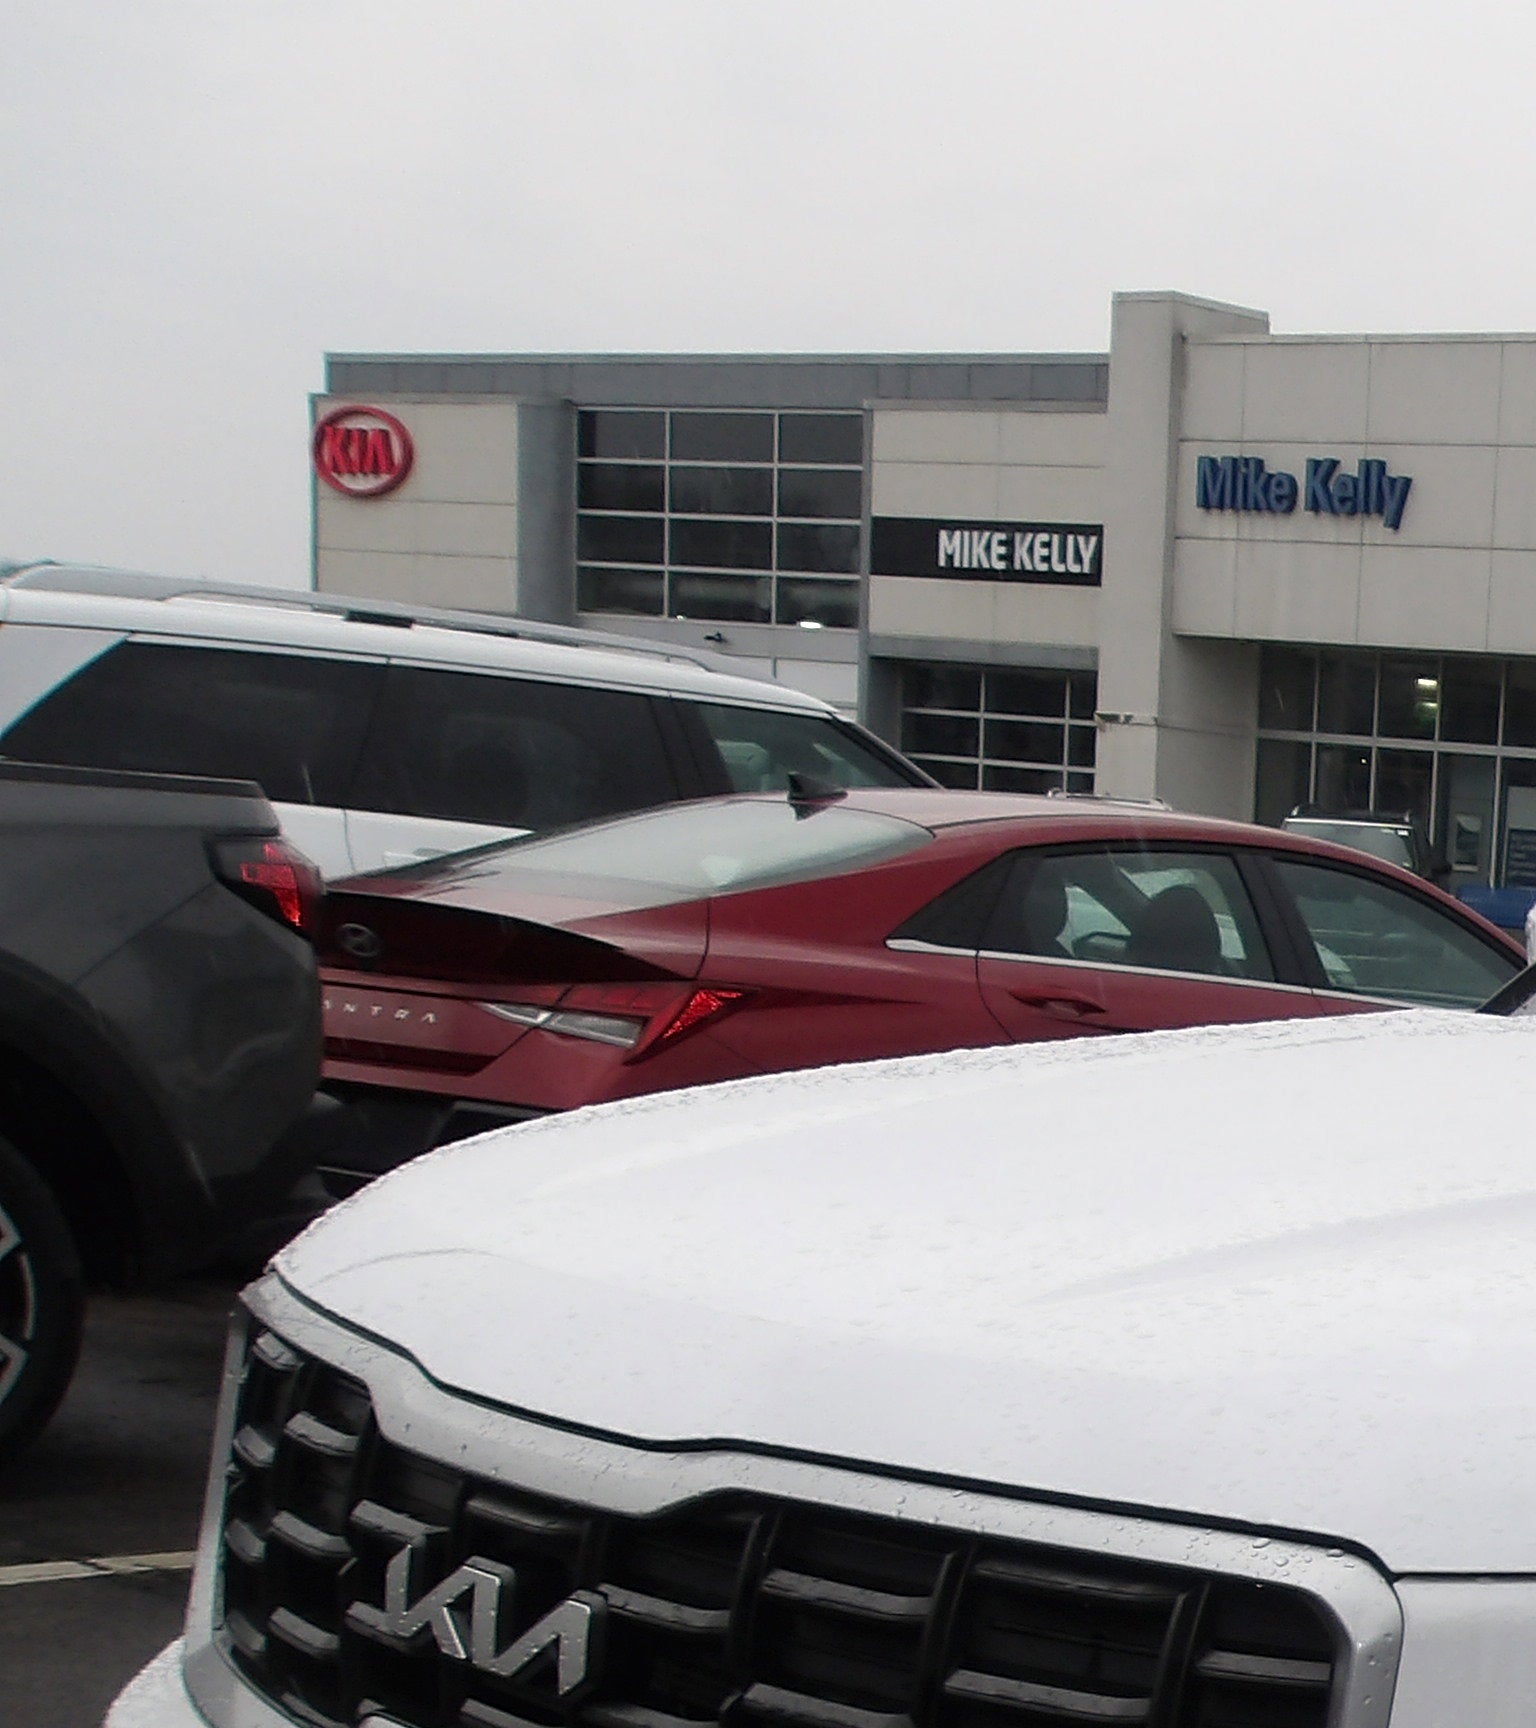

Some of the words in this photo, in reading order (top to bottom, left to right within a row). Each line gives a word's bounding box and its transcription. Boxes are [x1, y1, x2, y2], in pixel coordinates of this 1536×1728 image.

[324, 424, 397, 475] KIA
[1196, 455, 1297, 513] Mike
[1304, 457, 1412, 531] Kelly
[938, 529, 1007, 571] MIKE
[1013, 532, 1098, 574] KELLY
[346, 1543, 597, 1696] KIA
